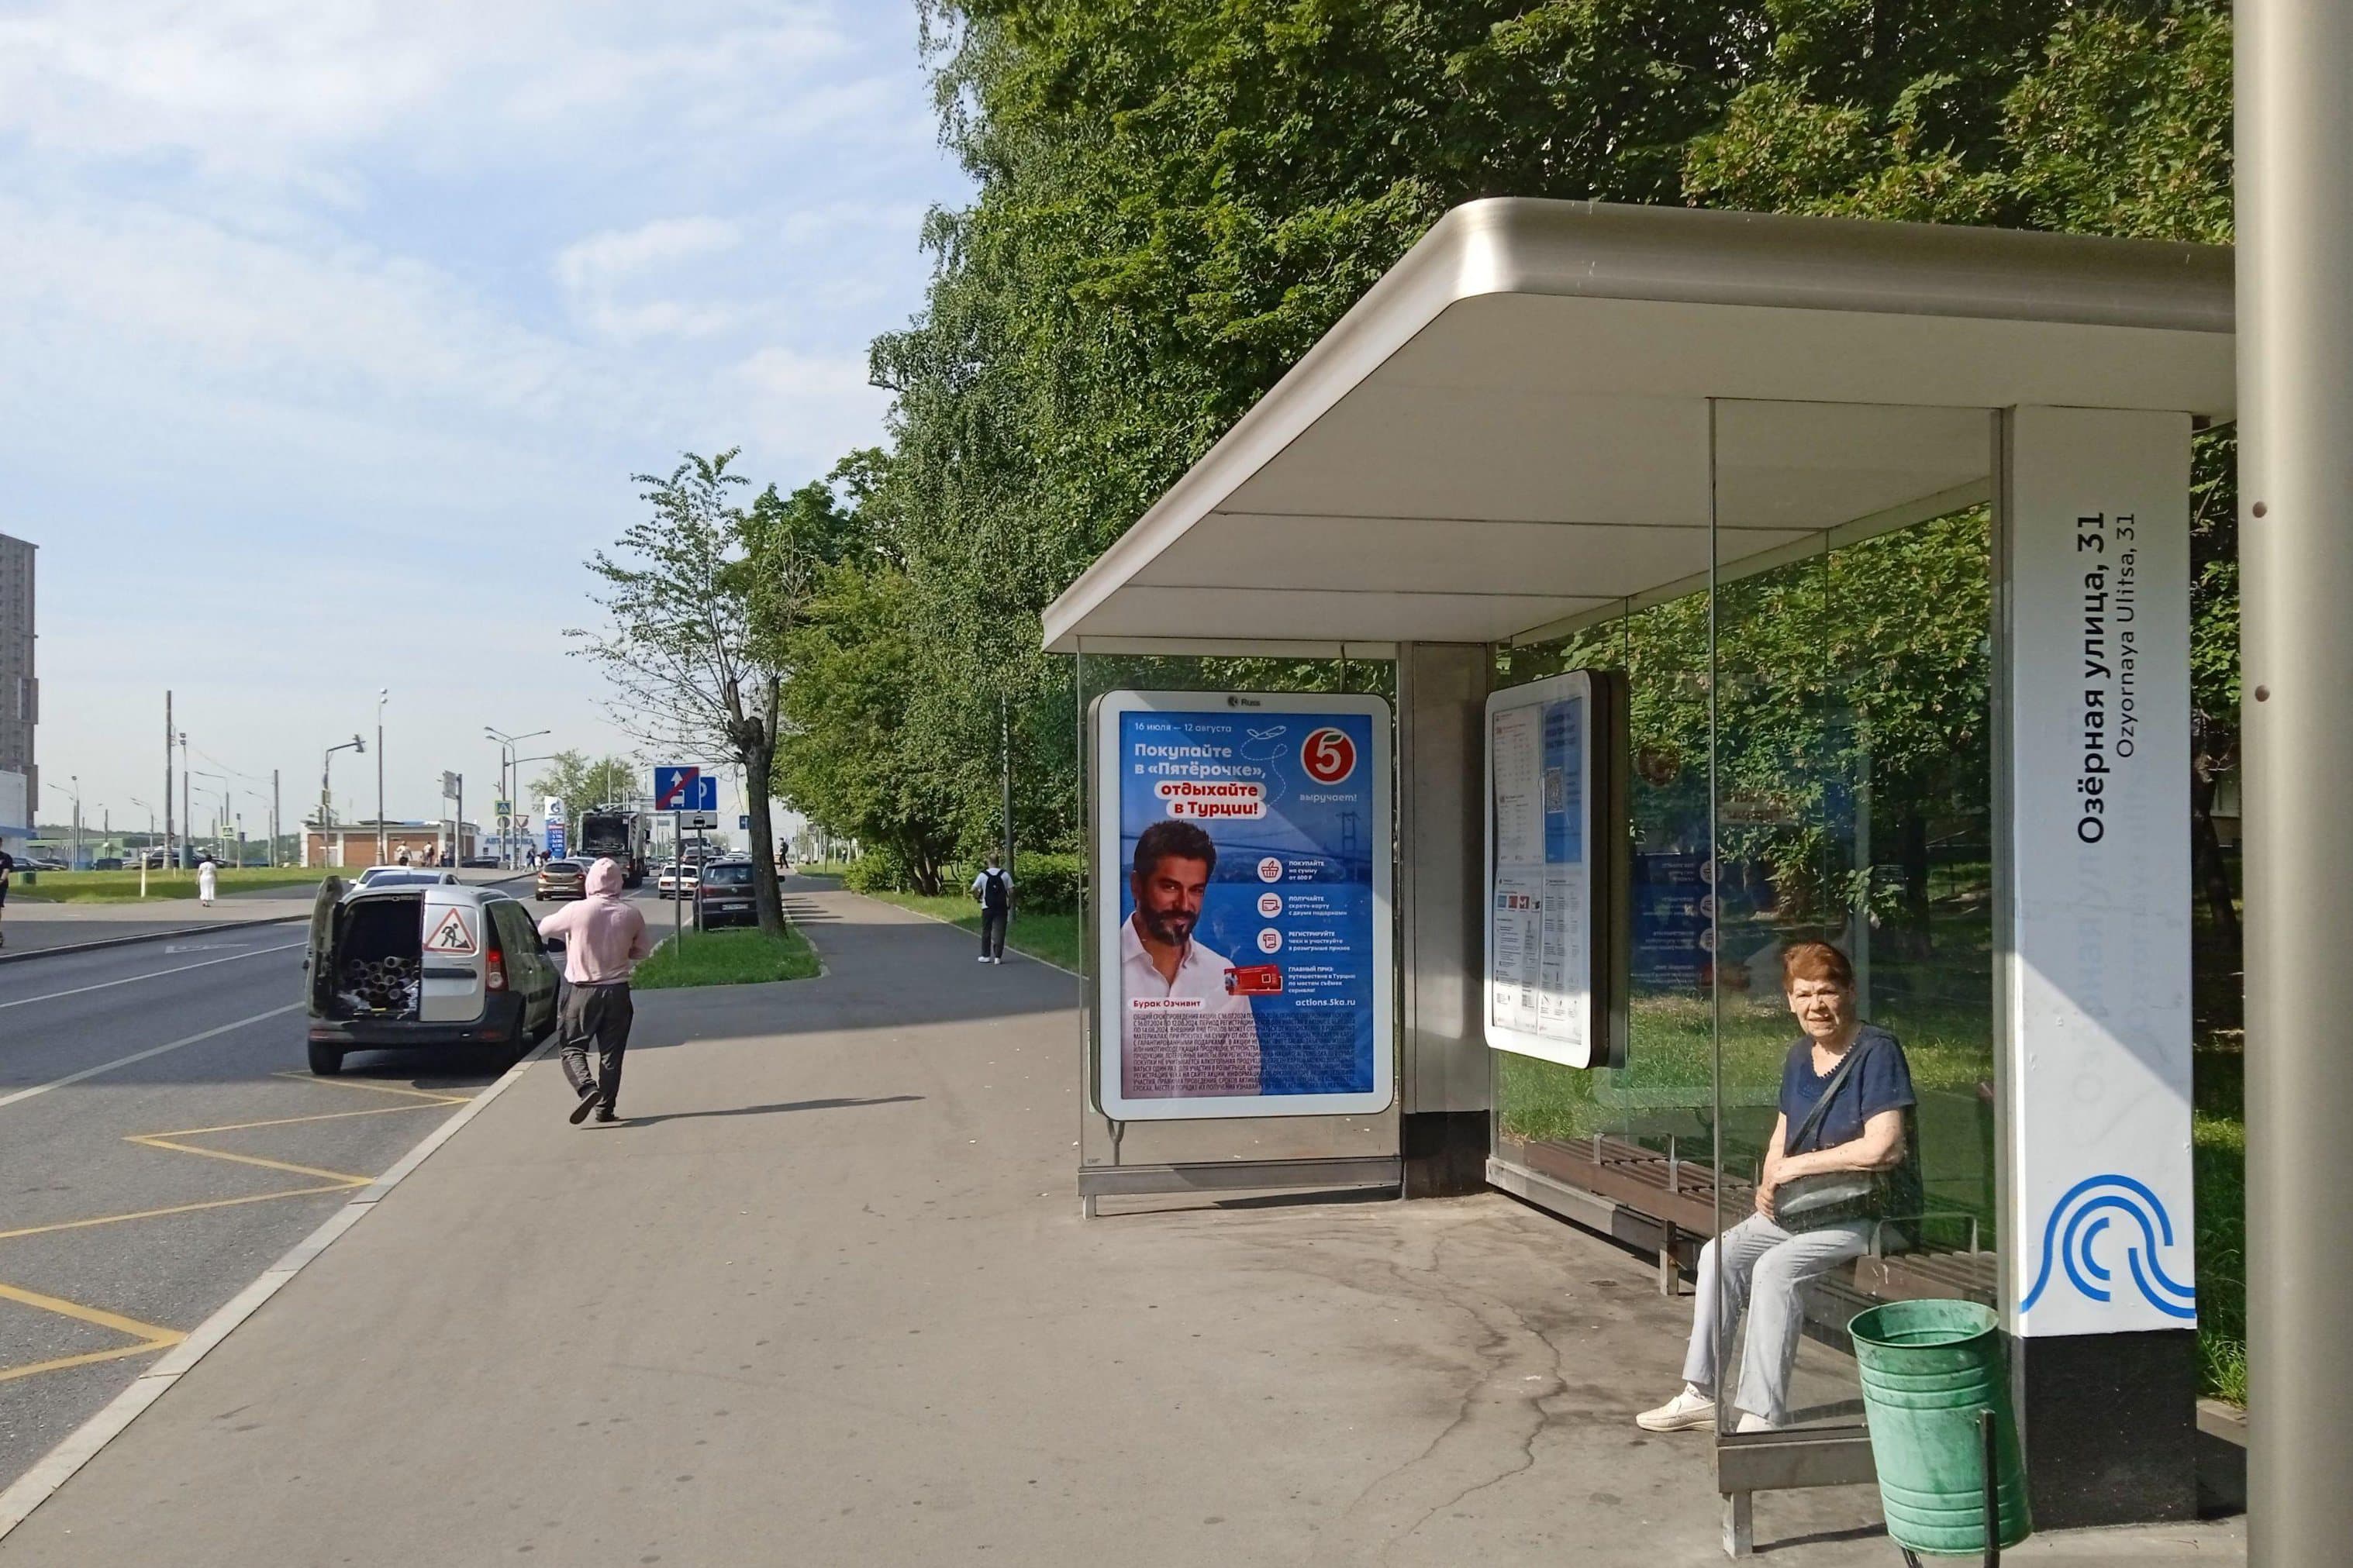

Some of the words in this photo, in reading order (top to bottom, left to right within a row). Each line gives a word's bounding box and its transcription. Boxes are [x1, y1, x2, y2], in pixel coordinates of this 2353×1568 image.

[2077, 512, 2104, 553] 31
[2117, 514, 2134, 540] 31
[2116, 548, 2137, 622] Ulitsa,
[2085, 564, 2111, 679] улица,
[1241, 698, 1261, 707] Russ
[2117, 631, 2138, 757] Ozyornaya
[1135, 722, 1144, 731] 16
[1147, 723, 1171, 732] июля
[1185, 723, 1193, 732] 12
[1195, 725, 1232, 734] августа
[1135, 743, 1233, 760] Покупайте
[1135, 764, 1144, 774] в
[1147, 760, 1266, 779] «Пятёрочке»,
[2077, 690, 2110, 843] Озёрная
[1161, 782, 1258, 797] отдыхайте
[1299, 794, 1358, 803] выручает!
[1175, 802, 1184, 814] в
[1188, 801, 1258, 817] Турции!
[1133, 1000, 1161, 1008] Бурак
